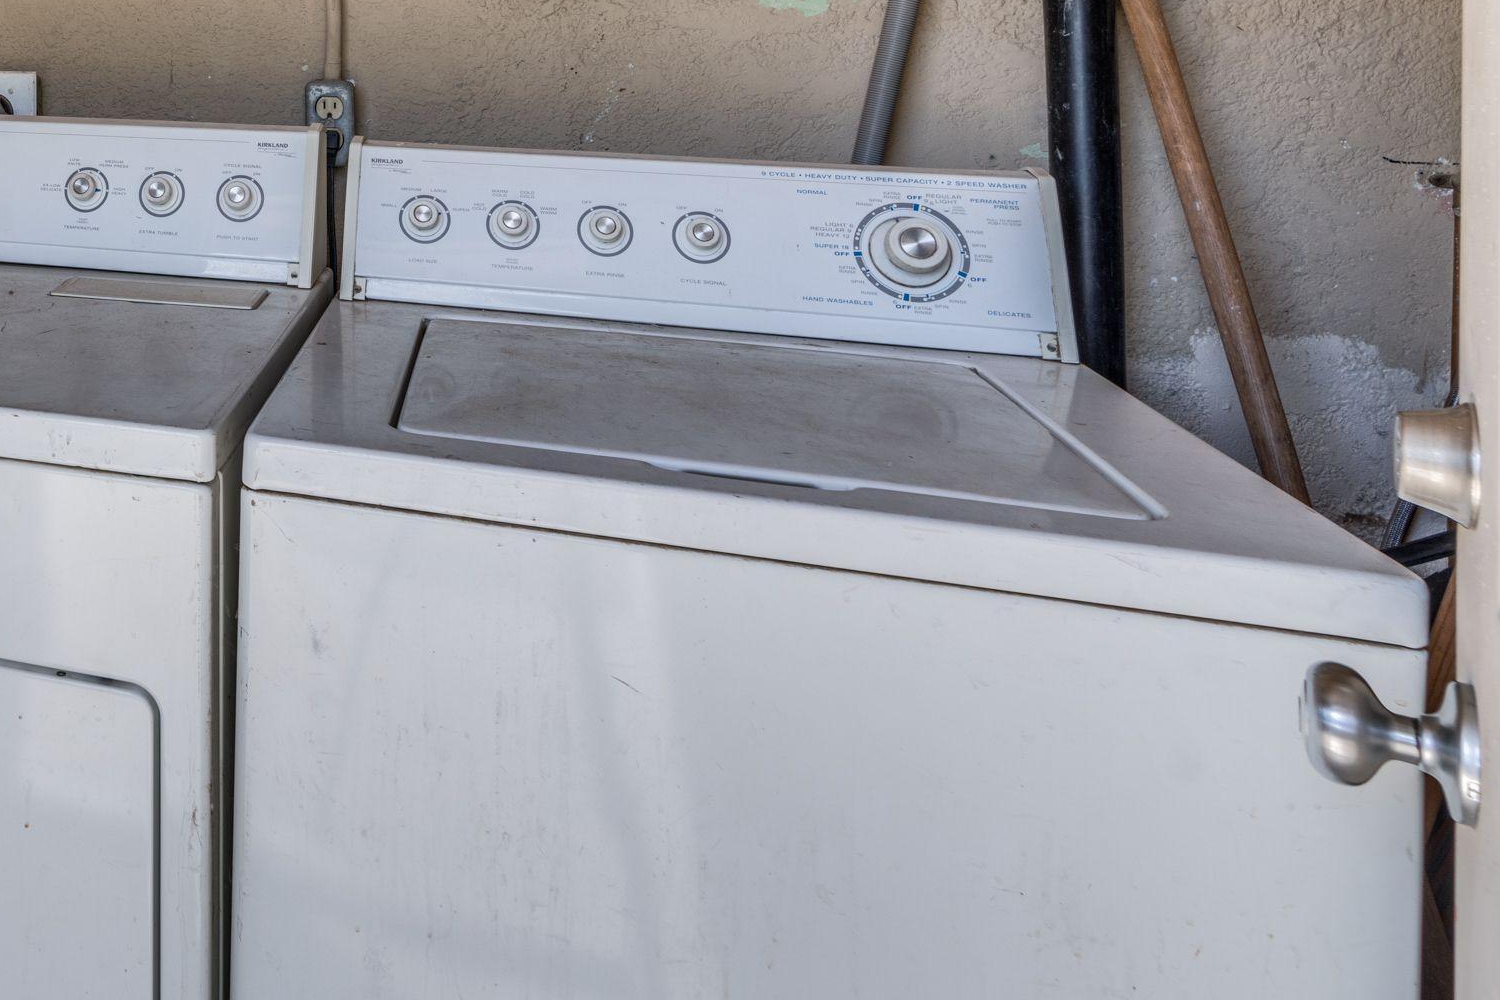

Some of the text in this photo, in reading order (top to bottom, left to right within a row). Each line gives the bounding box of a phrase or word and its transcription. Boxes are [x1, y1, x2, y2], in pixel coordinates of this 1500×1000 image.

[895, 177, 939, 185] CAPACITY
[954, 180, 985, 188] SPEED
[987, 182, 1027, 190] WASHER
[969, 198, 1019, 206] PERMANENT
[814, 242, 840, 250] SUPER
[491, 263, 534, 272] TEMPERATURE
[826, 298, 874, 306] WASHABLES
[987, 309, 1032, 319] DELICATES
